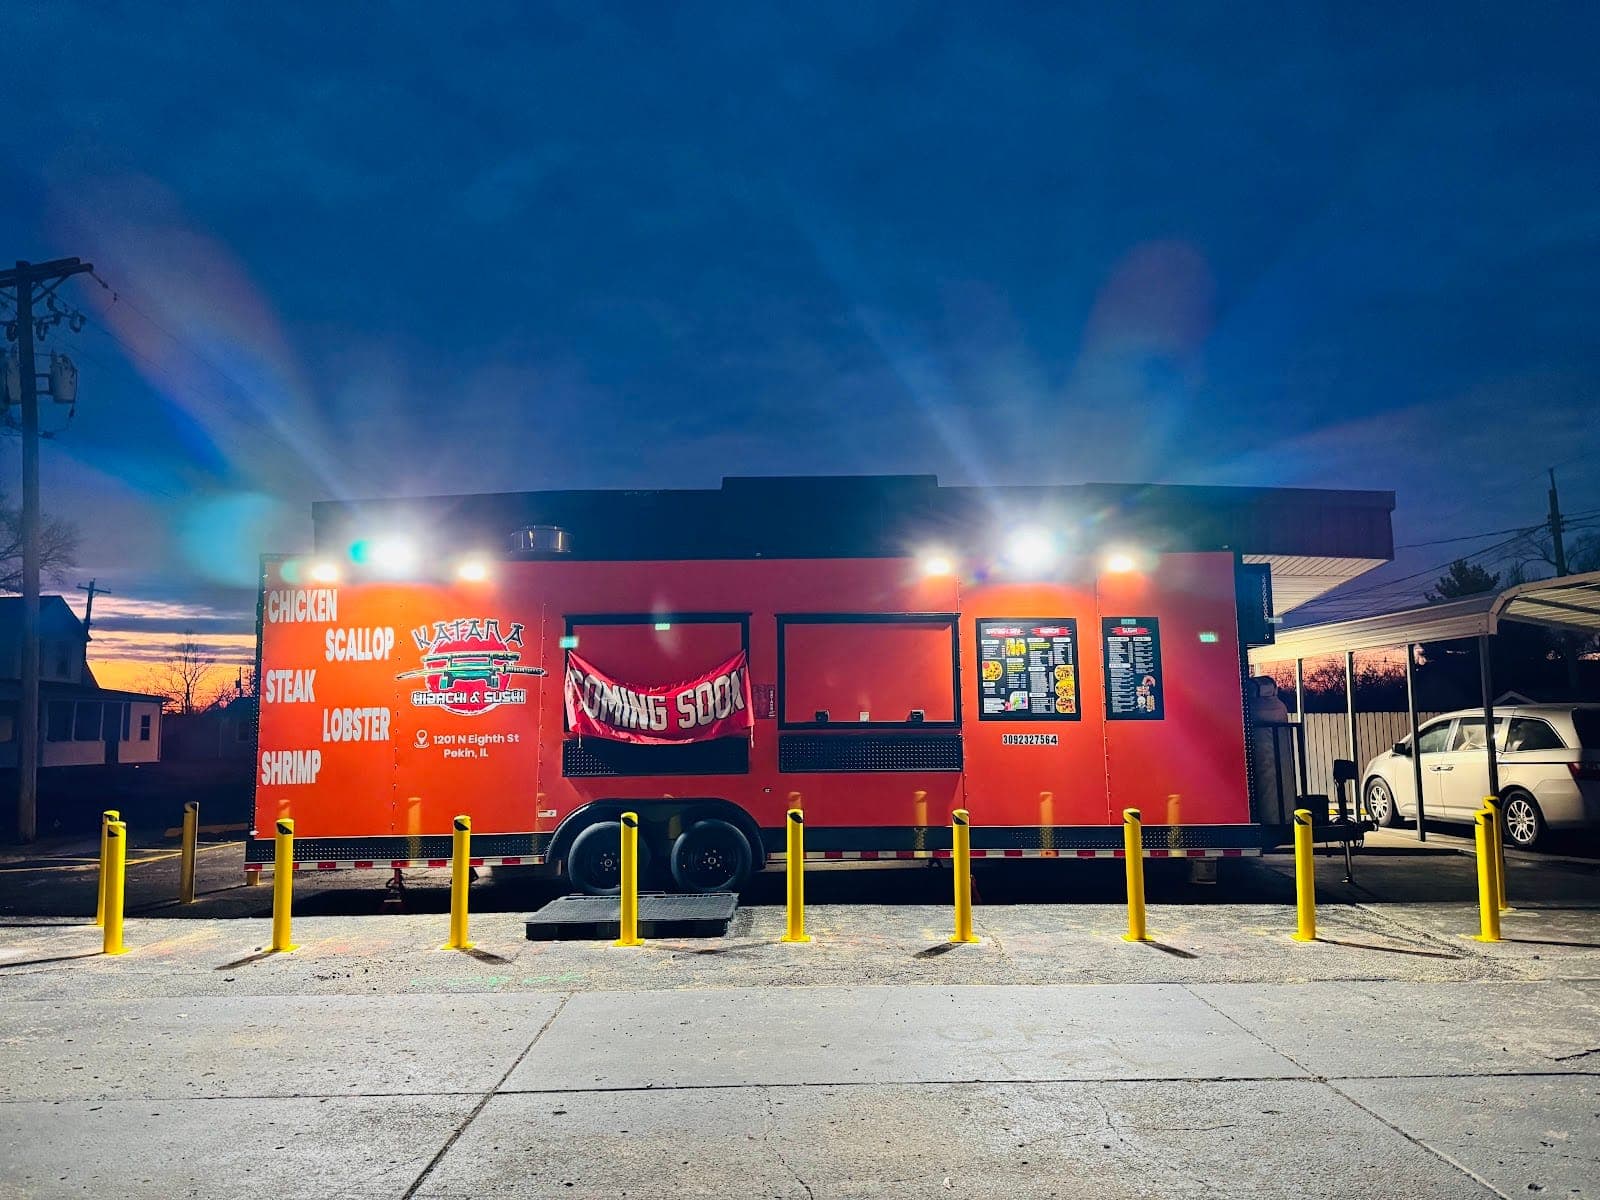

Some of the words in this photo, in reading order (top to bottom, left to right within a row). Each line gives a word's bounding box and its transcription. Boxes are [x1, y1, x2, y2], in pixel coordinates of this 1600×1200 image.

[268, 589, 337, 623] CHICKEN
[325, 627, 394, 662] SCALLOP
[411, 618, 524, 649] KATANA
[266, 669, 316, 704] STEAK
[412, 691, 467, 705] HIBACHI
[470, 692, 480, 703] &
[483, 690, 525, 703] SUSHI
[676, 668, 745, 729] SOON
[323, 708, 391, 743] LOBSTER
[433, 735, 455, 745] 1201
[457, 734, 466, 744] N
[468, 734, 504, 746] Eighth
[507, 733, 520, 743] St
[261, 750, 321, 785] SHRIMP
[480, 748, 488, 757] IL
